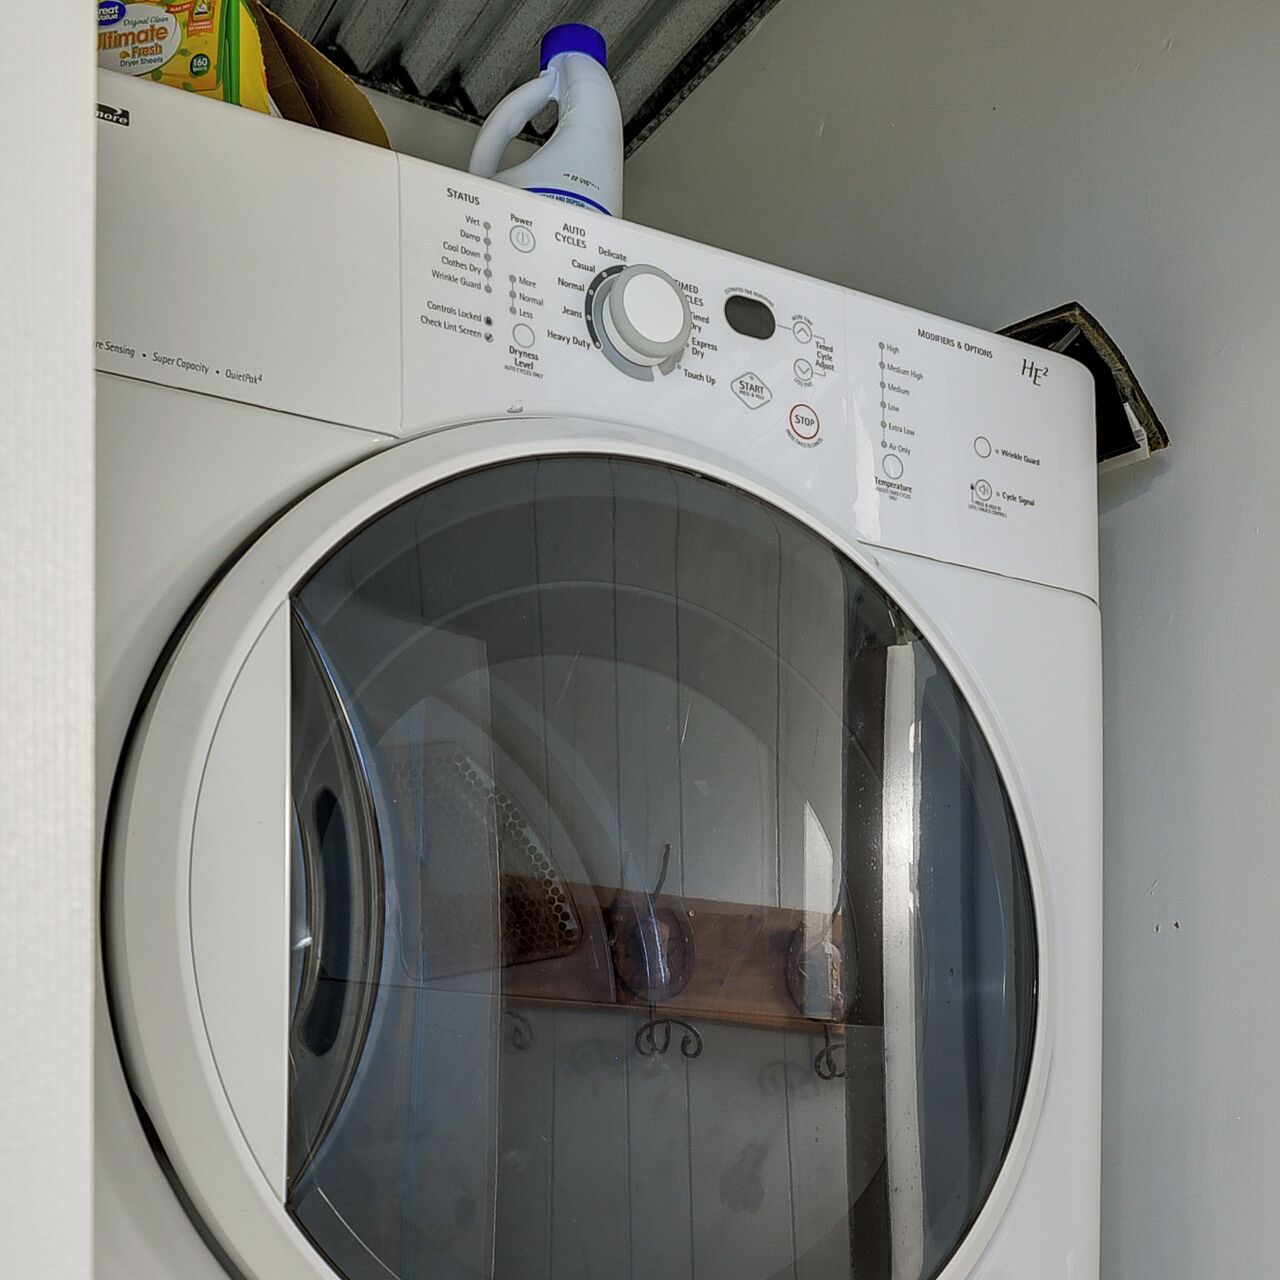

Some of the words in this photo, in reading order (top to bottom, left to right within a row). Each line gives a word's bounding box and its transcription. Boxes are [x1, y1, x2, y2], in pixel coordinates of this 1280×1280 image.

[98, 5, 119, 15] reat
[98, 25, 169, 50] ltimate
[131, 43, 163, 58] Fresh
[120, 59, 140, 68] Dryer
[140, 57, 163, 65] Sheets
[193, 58, 208, 67] 160
[447, 188, 480, 205] STATUS
[465, 215, 480, 226] Wet
[510, 213, 533, 227] Power
[460, 229, 481, 243] Damp
[562, 223, 586, 237] AUTO
[555, 232, 587, 249] CYCLES
[443, 241, 459, 252] Cool
[461, 246, 481, 258] Down
[598, 246, 627, 262] Delicate
[441, 256, 468, 271] Clothes
[469, 263, 482, 275] Dry
[571, 259, 596, 273] Casual
[432, 269, 459, 285] Wrinkle
[460, 277, 482, 290] Guard
[519, 277, 536, 288] More
[557, 277, 585, 292] Normal
[519, 293, 544, 307] Normal
[427, 301, 457, 316] Controls
[458, 309, 482, 322] Locked
[520, 309, 534, 319] Less
[562, 306, 582, 319] Jeans
[420, 315, 442, 328] Check
[444, 321, 457, 333] Lint
[459, 325, 482, 338] Screen
[547, 329, 571, 345] Heavy
[572, 337, 591, 350] Duty
[692, 337, 718, 352] Express
[917, 328, 955, 348] MODIFIERS
[957, 341, 963, 350] &
[964, 343, 993, 359] OPTIONS
[509, 345, 539, 361] Dryness
[692, 347, 705, 359] Dry
[815, 342, 834, 353] Timed
[887, 344, 900, 355] High
[105, 341, 135, 359] Sensing
[152, 352, 175, 366] Super
[176, 358, 210, 375] Capacity
[817, 351, 833, 362] Cycle
[515, 358, 534, 370] Level
[815, 360, 835, 372] Adjust
[684, 369, 705, 382] Touch
[706, 373, 717, 386] Up
[887, 363, 910, 376] Medium
[911, 369, 924, 381] High
[739, 380, 764, 394] START
[888, 383, 910, 395] Medium
[888, 403, 900, 412] Low
[795, 414, 815, 427] STOP
[888, 423, 903, 433] Extra
[904, 427, 915, 436] Low
[889, 443, 898, 452] Air
[898, 445, 911, 455] Only
[1001, 448, 1023, 462] Wrinkle
[1024, 455, 1041, 467] Guard
[875, 476, 913, 493] Temperature
[1002, 492, 1017, 504] Cycle
[1019, 495, 1036, 507] Signal
